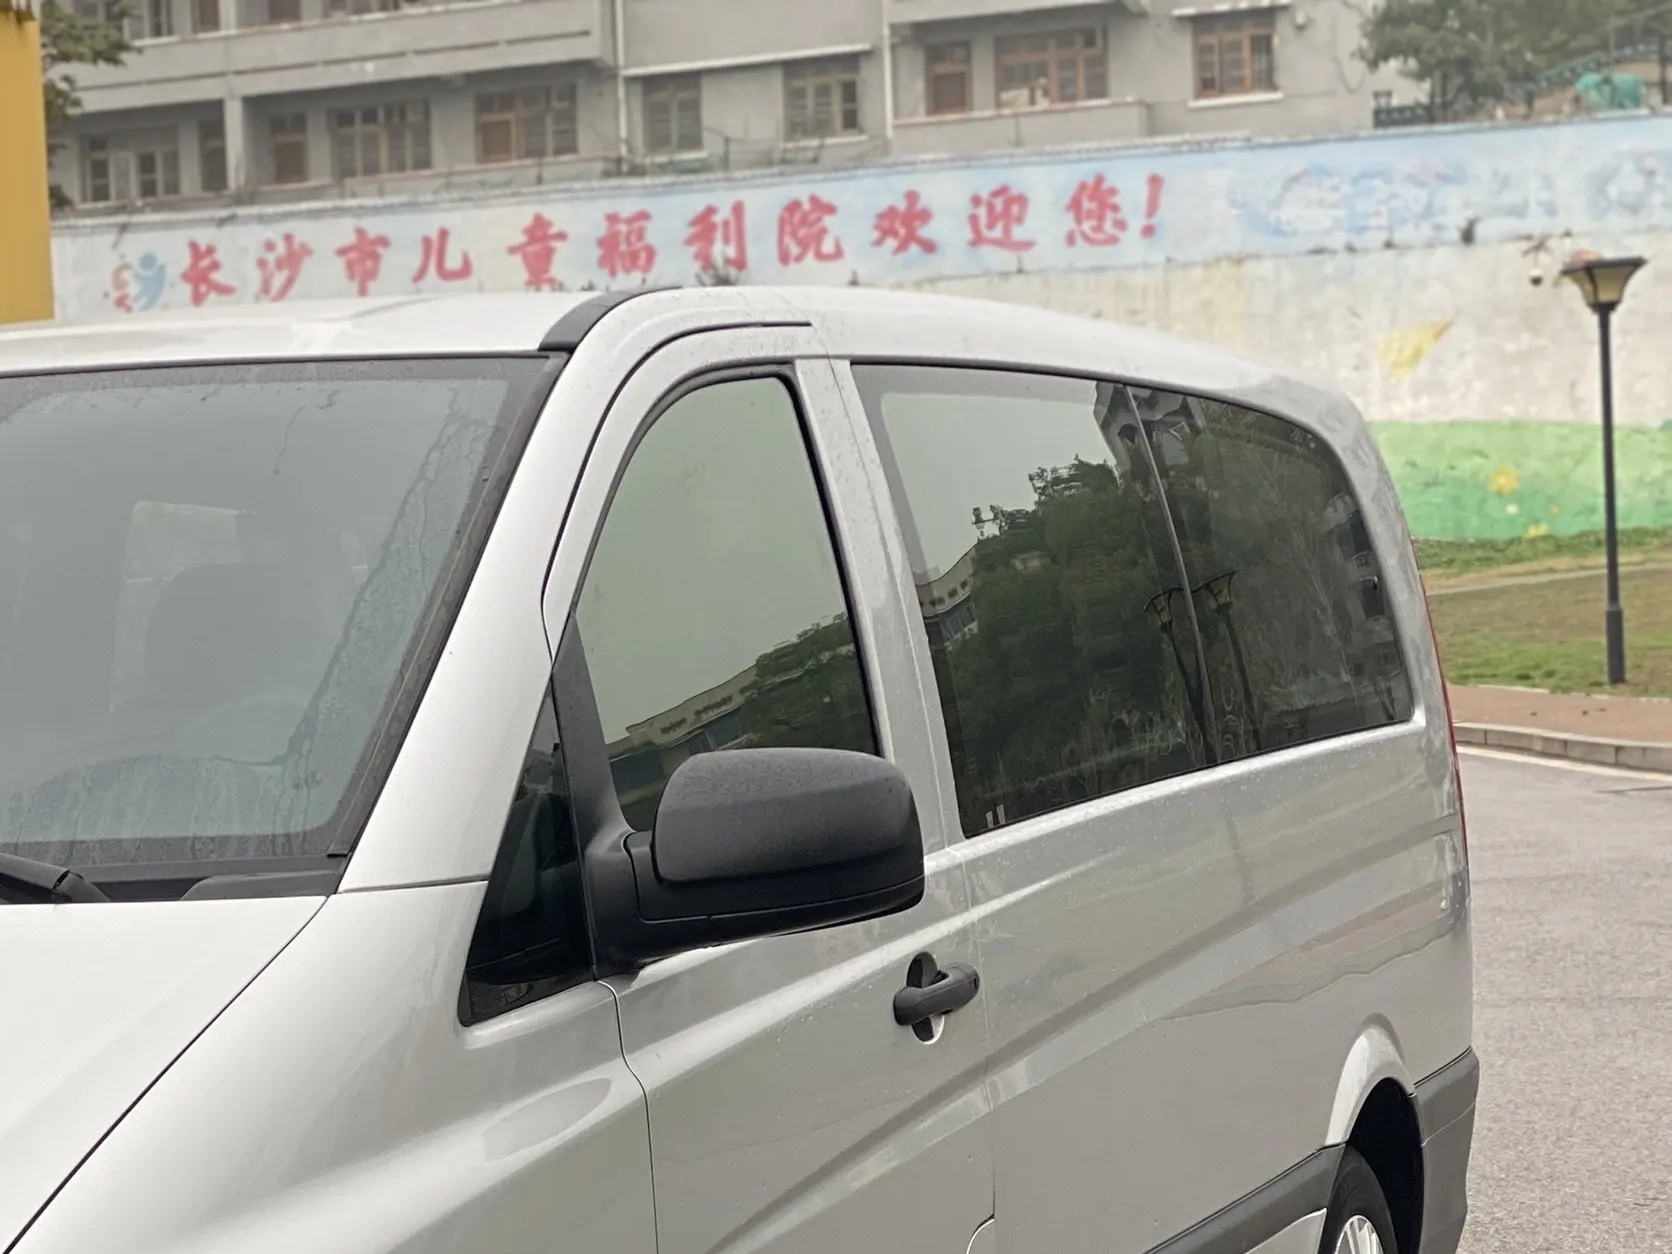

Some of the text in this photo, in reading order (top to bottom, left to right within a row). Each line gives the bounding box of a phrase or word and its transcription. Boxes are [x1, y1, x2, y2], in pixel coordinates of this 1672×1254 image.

[180, 173, 1164, 308] 长沙市儿童福利院欢迎您!
